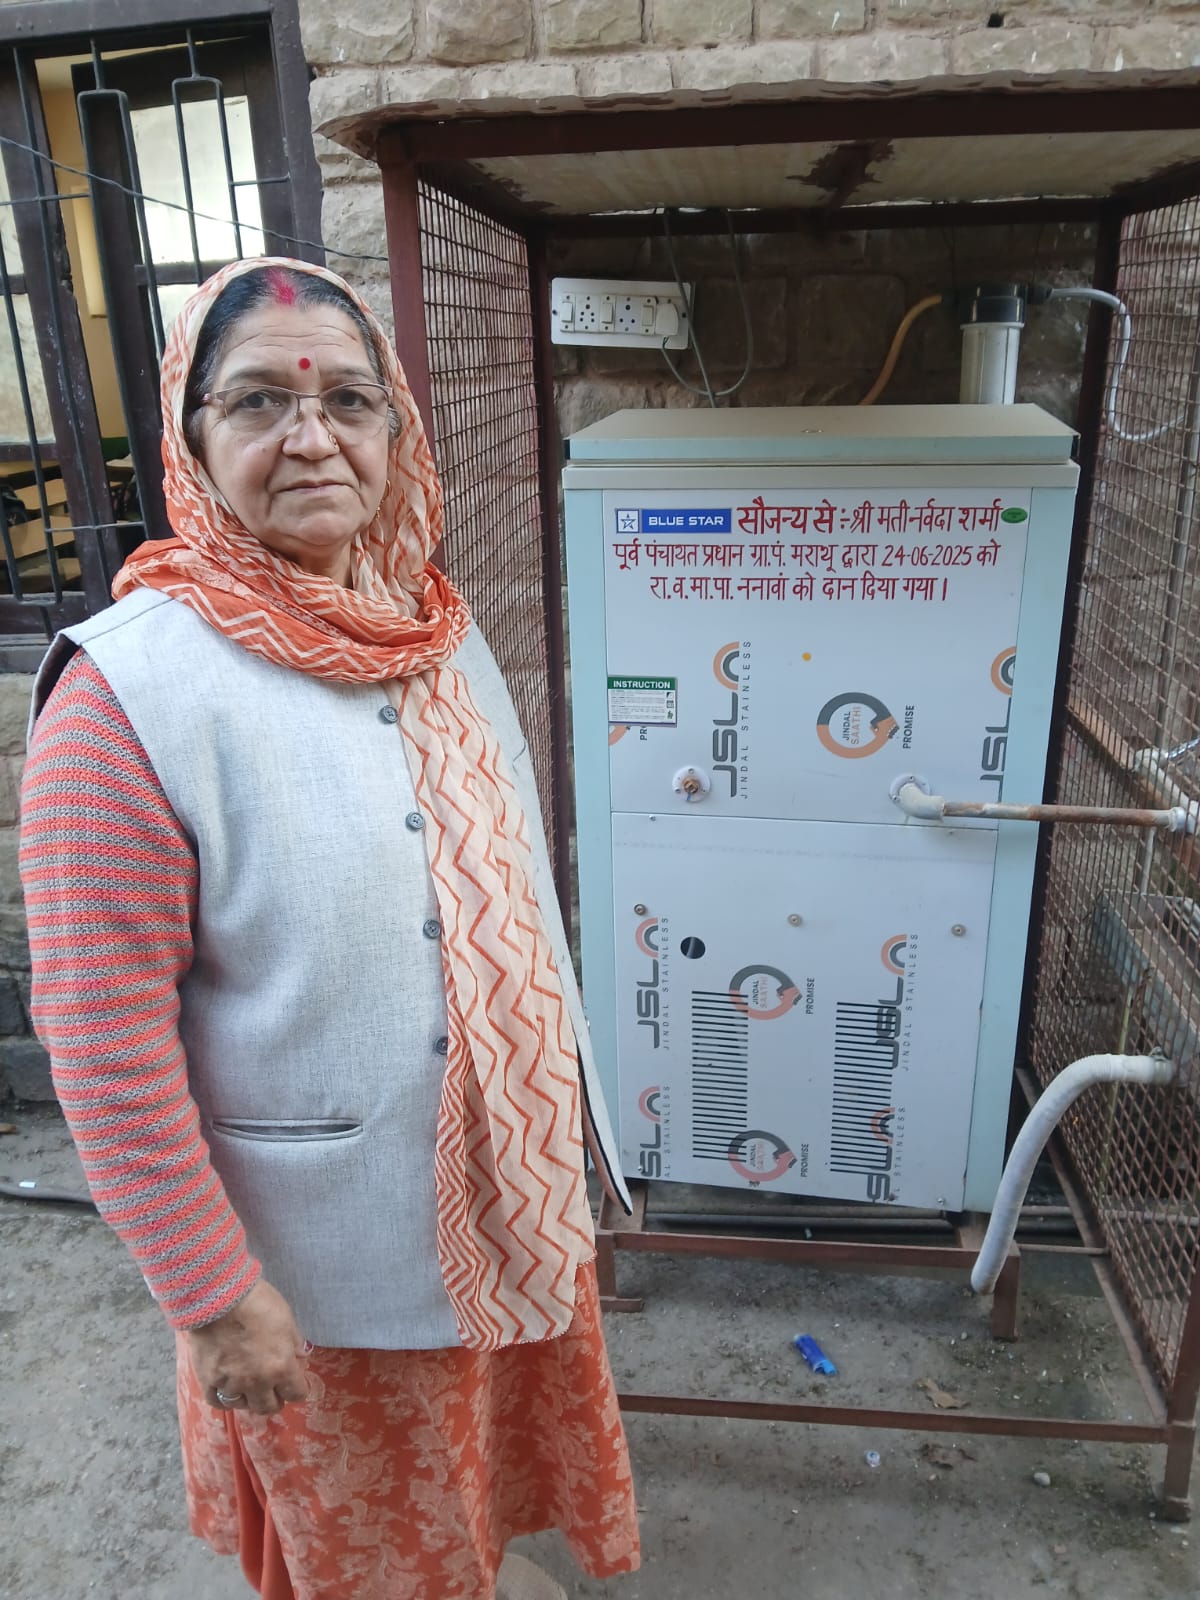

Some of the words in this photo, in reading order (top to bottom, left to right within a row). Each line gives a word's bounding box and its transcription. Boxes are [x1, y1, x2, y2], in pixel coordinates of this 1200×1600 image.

[648, 516, 684, 526] BLUE
[688, 516, 724, 526] STAR
[644, 540, 700, 567] पंचायत
[701, 544, 745, 567] प्रधान
[881, 545, 973, 567] 24-06-2025
[976, 538, 1001, 566] को
[792, 572, 816, 601] को
[822, 577, 858, 600] दान
[861, 570, 899, 600] दिया
[613, 680, 671, 689] INSTRUCTION
[741, 641, 751, 732] STAINLESS
[712, 691, 738, 798] JSL
[842, 711, 851, 741] JINDAL
[902, 704, 915, 749] PROMISE
[740, 745, 750, 799] JINDAL
[661, 917, 669, 993] STAINLESS
[905, 933, 918, 1011] STAINLESS
[636, 958, 660, 1049] JSL
[752, 979, 760, 1005] JINDAL
[805, 977, 815, 1015] PROMISE
[662, 1004, 670, 1050] JINDAL
[902, 1023, 912, 1071] JINDAL
[800, 1143, 809, 1178] PROMISE
